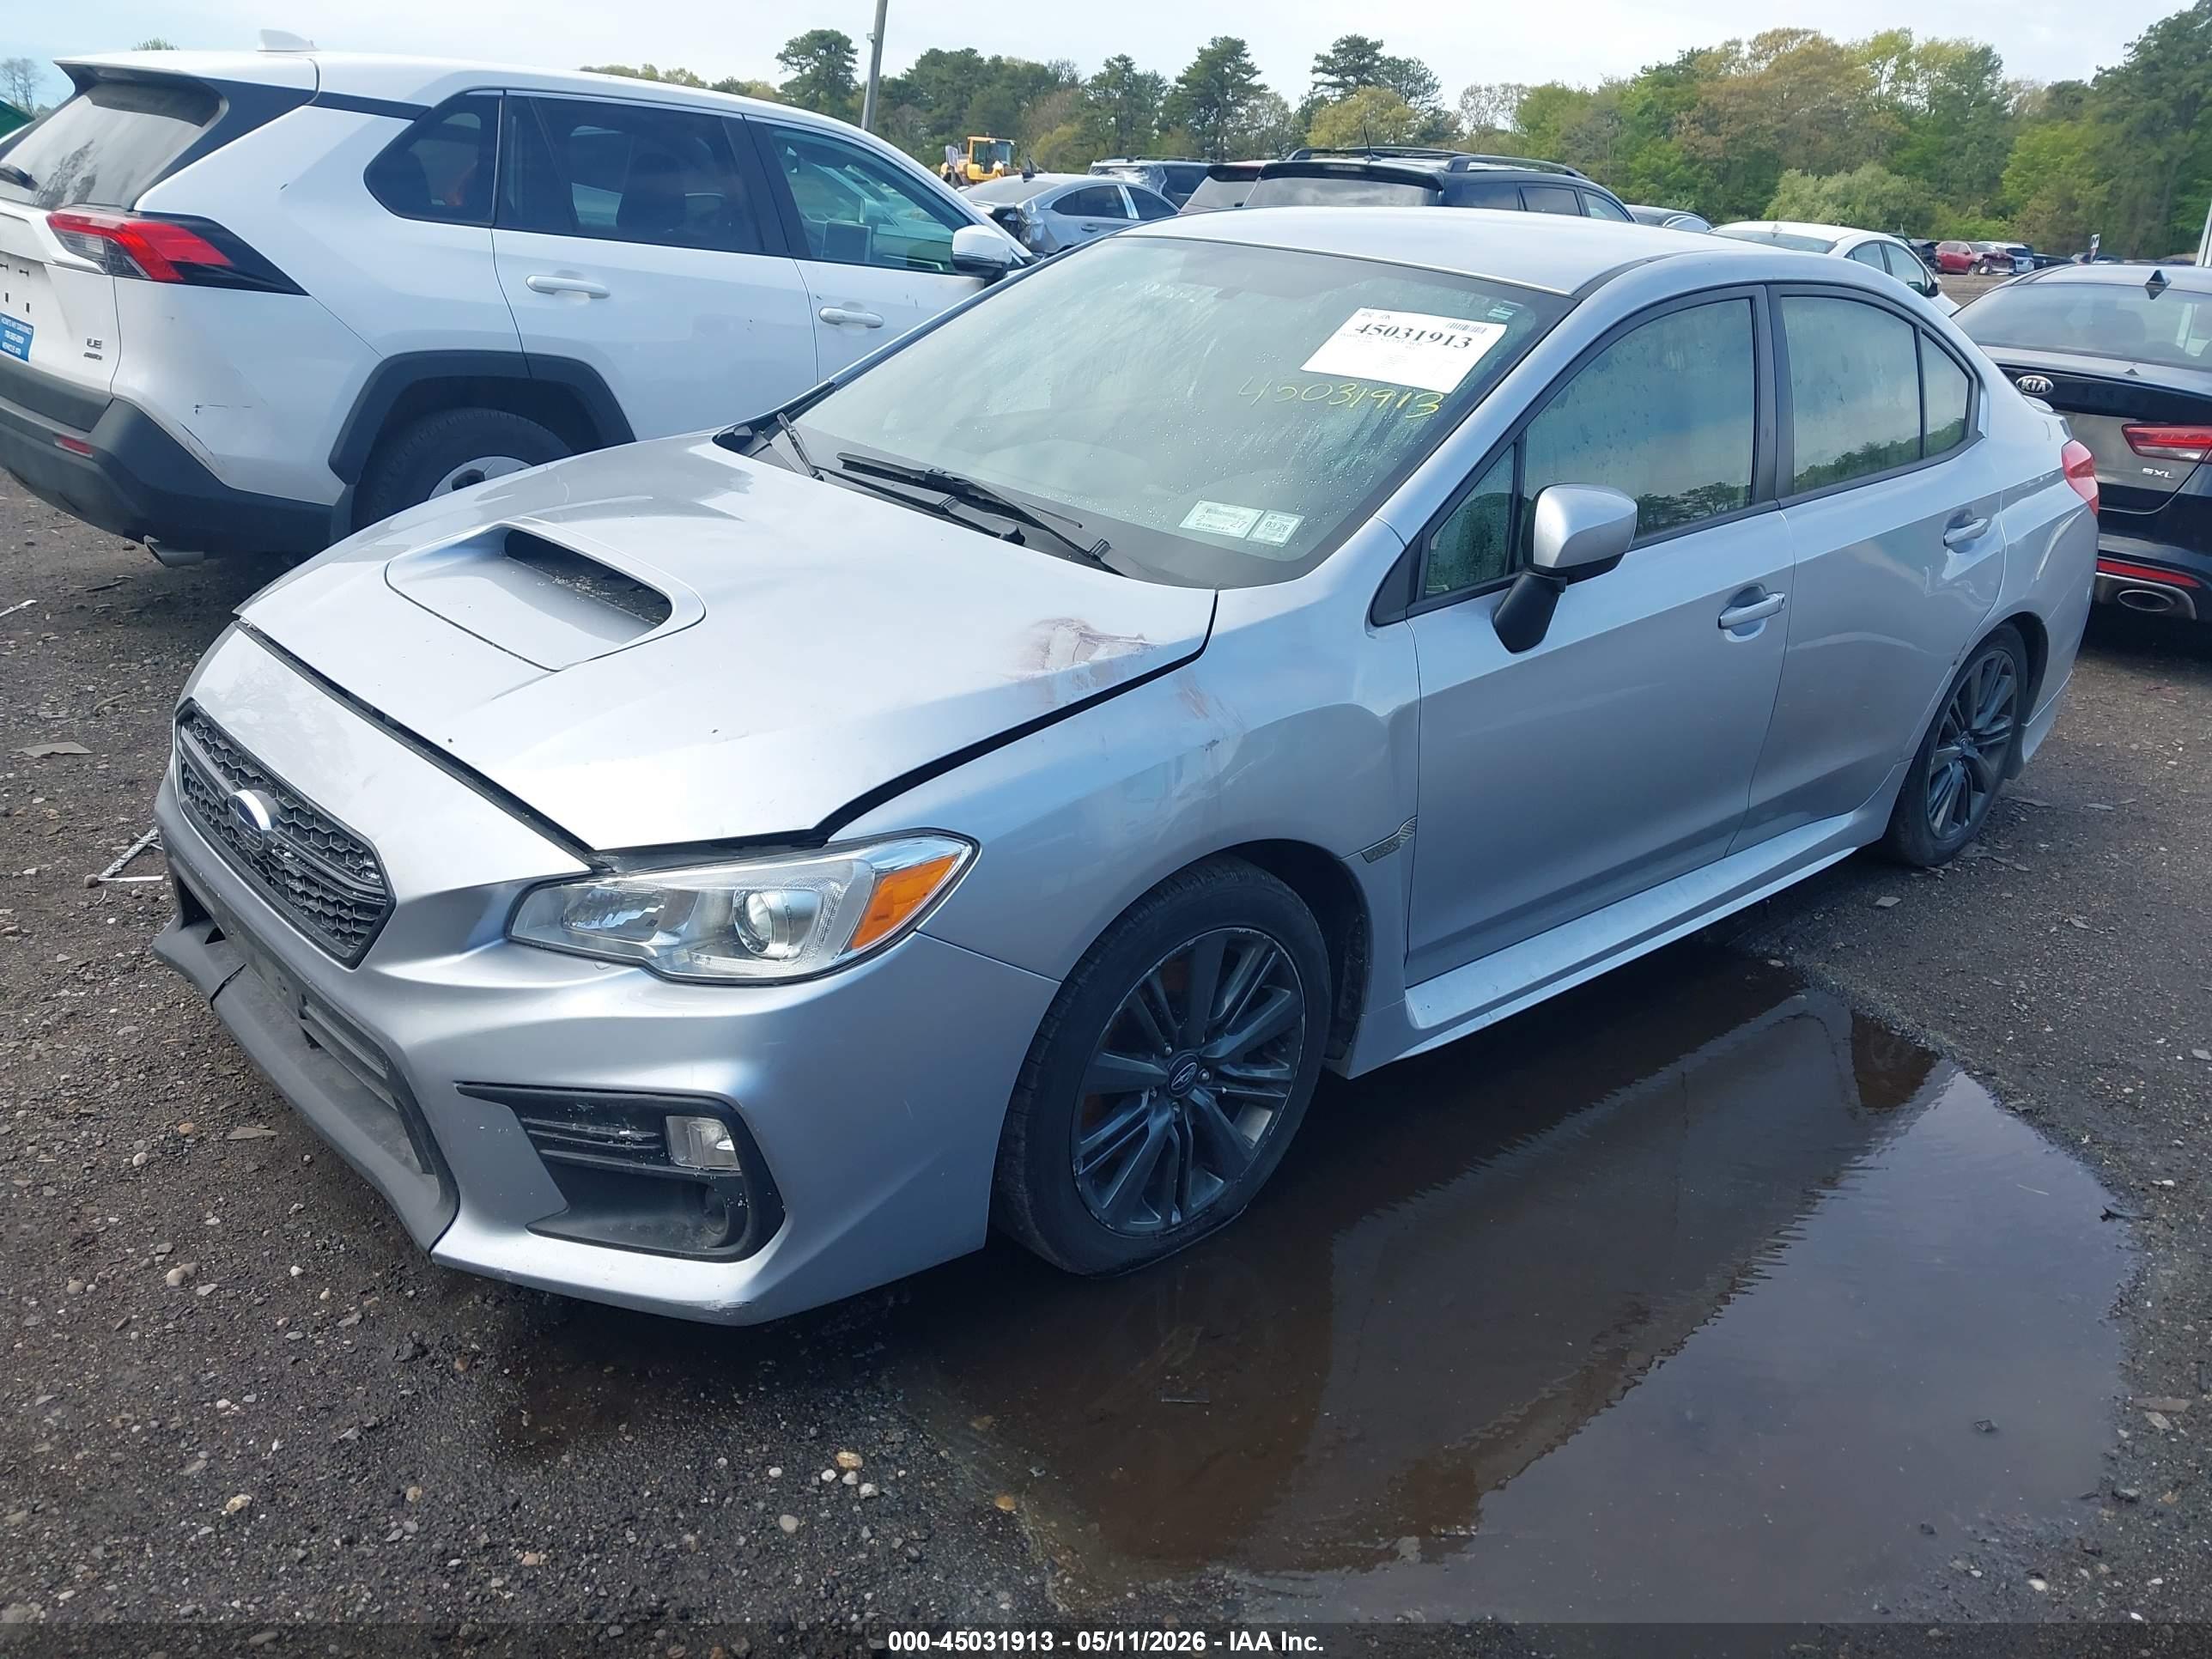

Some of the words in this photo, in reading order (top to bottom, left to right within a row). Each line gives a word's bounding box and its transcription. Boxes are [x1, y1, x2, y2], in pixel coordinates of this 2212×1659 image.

[1354, 323, 1473, 349] 45031913
[2021, 378, 2047, 392] KIA
[1237, 377, 1445, 418] 45031913
[2142, 467, 2174, 479] SXL
